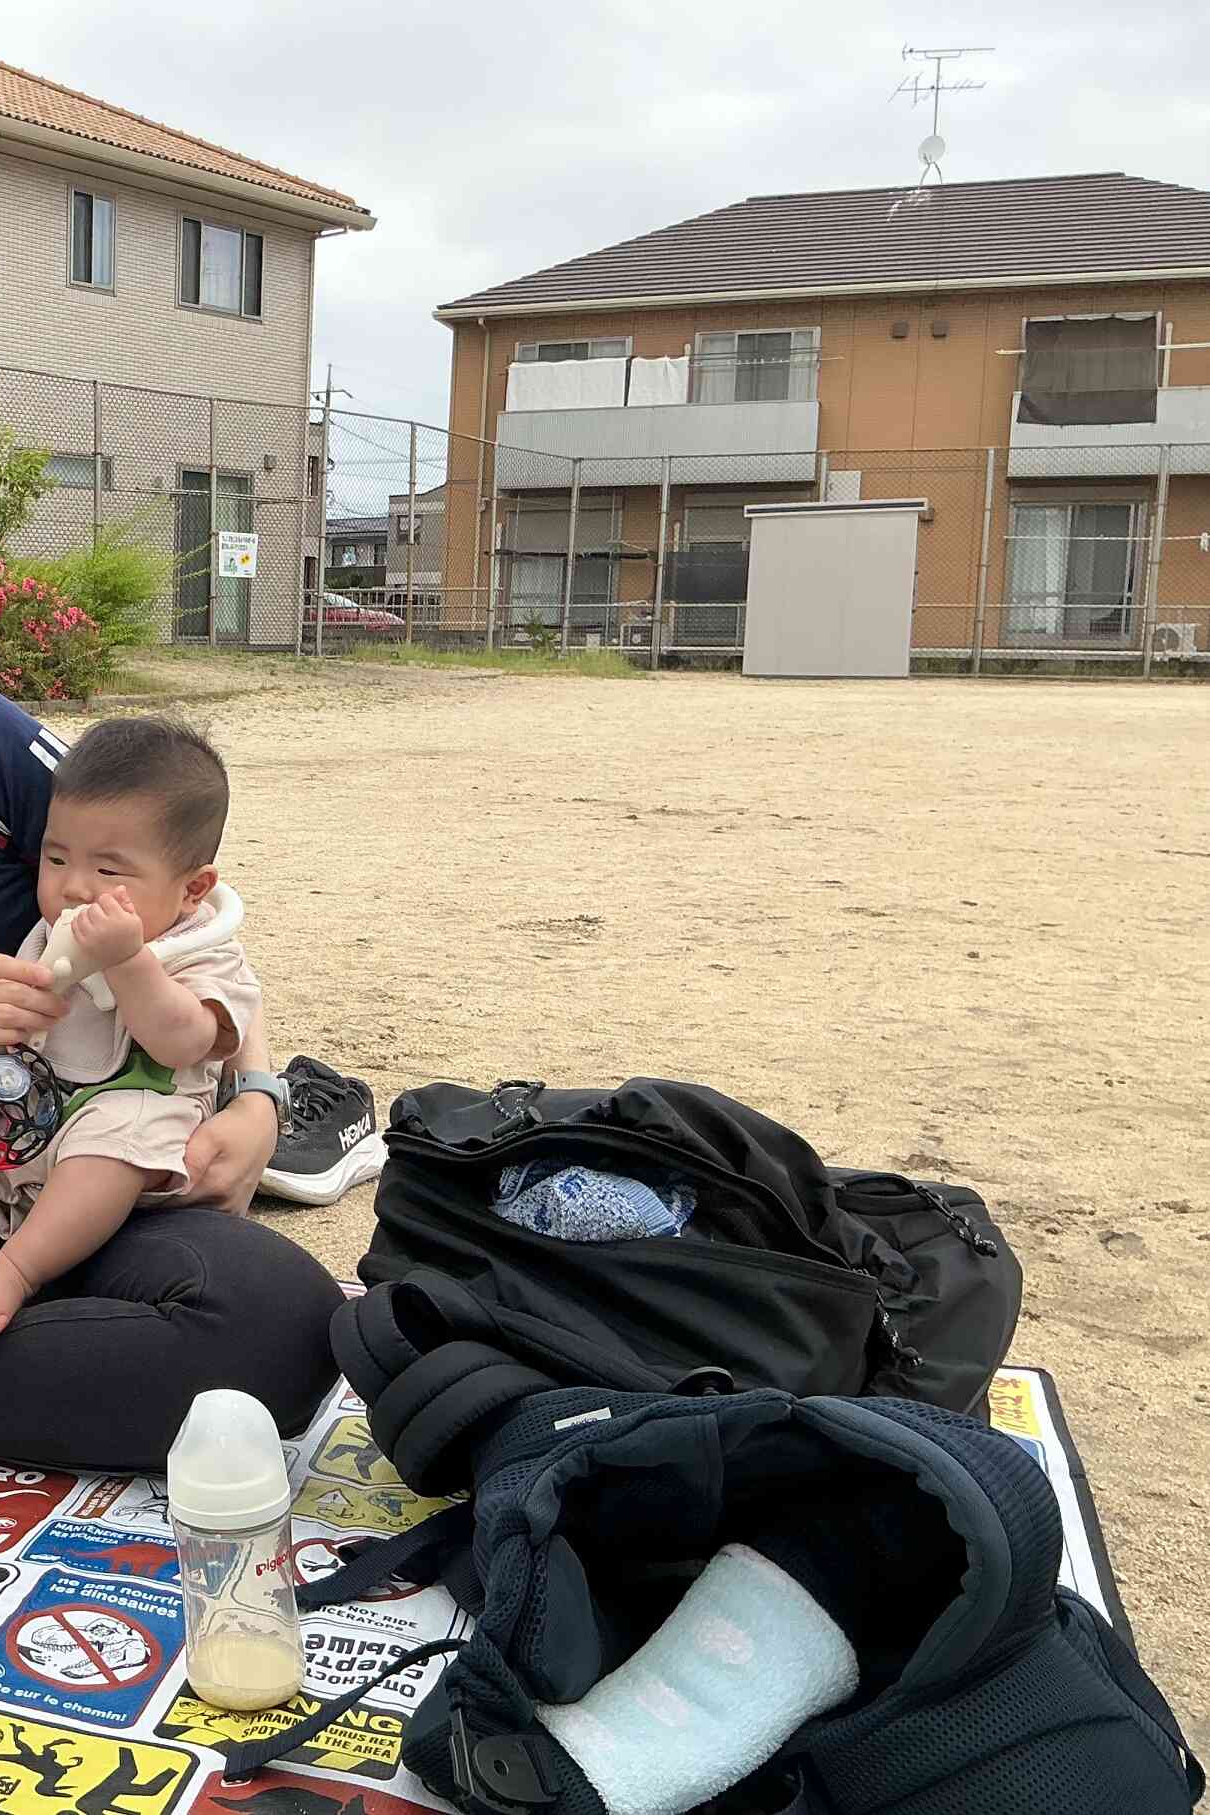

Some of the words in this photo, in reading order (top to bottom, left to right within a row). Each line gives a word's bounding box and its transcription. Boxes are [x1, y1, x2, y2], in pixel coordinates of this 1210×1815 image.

[338, 1111, 372, 1151] HOKA
[49, 1584, 75, 1594] les
[79, 1587, 178, 1618] dinosaures
[57, 1577, 76, 1586] ne
[83, 1582, 115, 1593] pas
[120, 1586, 182, 1606] nourrir
[348, 1605, 378, 1617] NOT
[382, 1615, 419, 1629] RIDE
[13, 1688, 41, 1701] sur
[43, 1693, 59, 1706] le
[62, 1701, 128, 1722] chemin!
[324, 1734, 351, 1751] THE
[352, 1743, 392, 1759] AREA
[367, 1736, 397, 1748] REX
